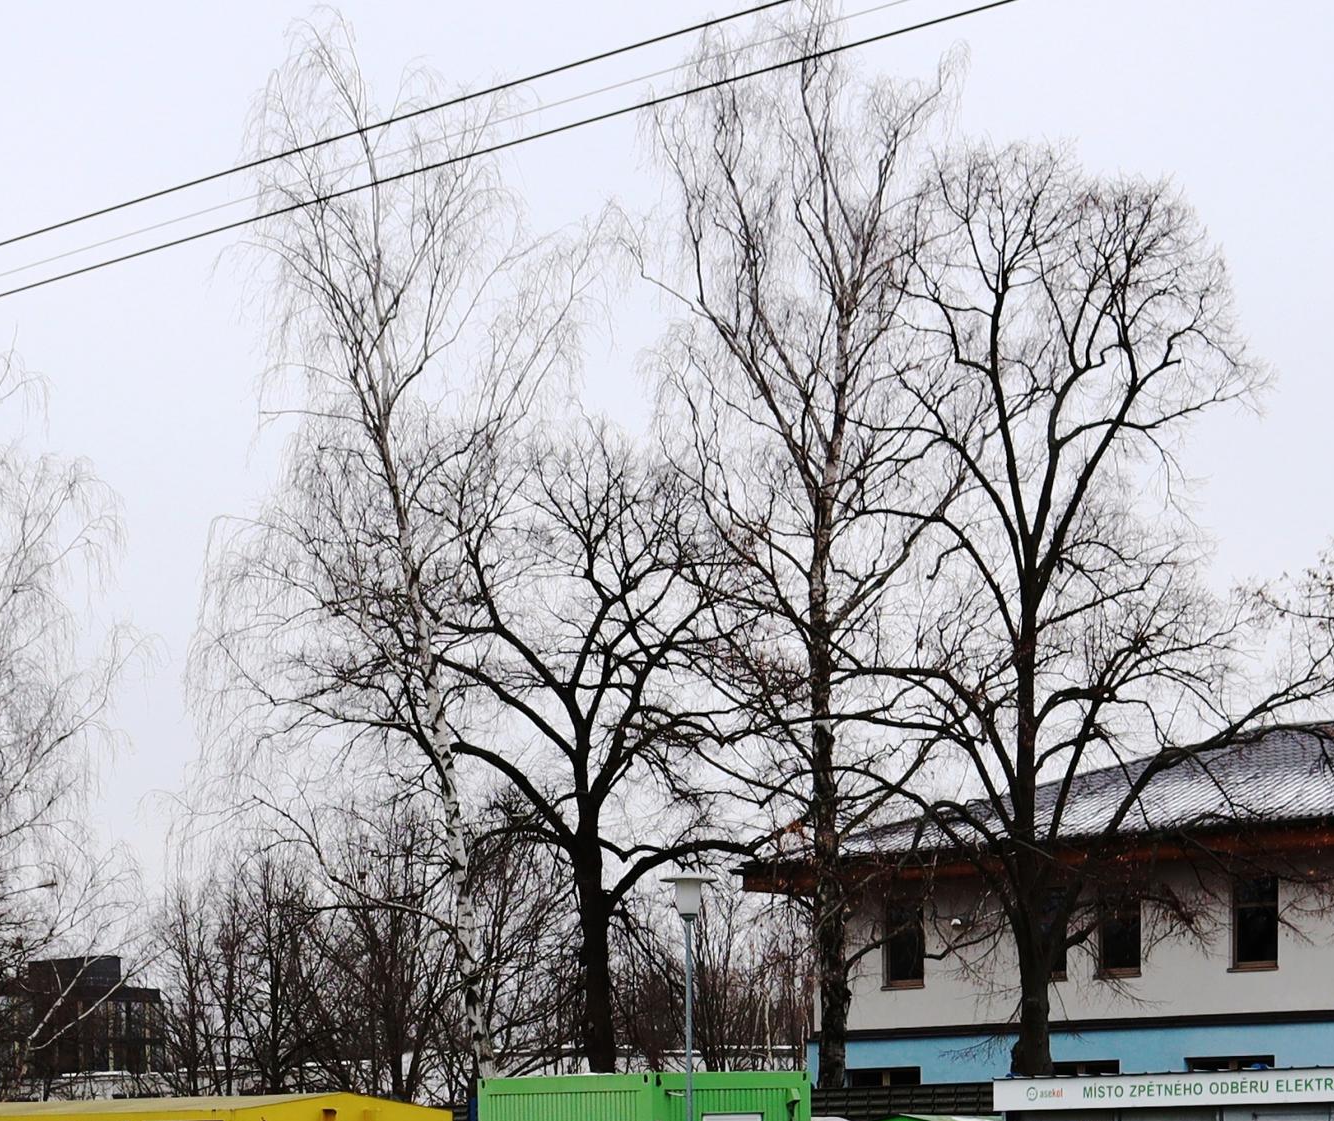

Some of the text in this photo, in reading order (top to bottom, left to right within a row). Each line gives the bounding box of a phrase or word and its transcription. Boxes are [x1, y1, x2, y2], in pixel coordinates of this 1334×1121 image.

[1039, 1087, 1063, 1099] asekol
[1083, 1083, 1124, 1099] MÍSTO
[1129, 1080, 1203, 1098] ZPĚTNÉHO
[1209, 1077, 1269, 1096] ODBĚRU
